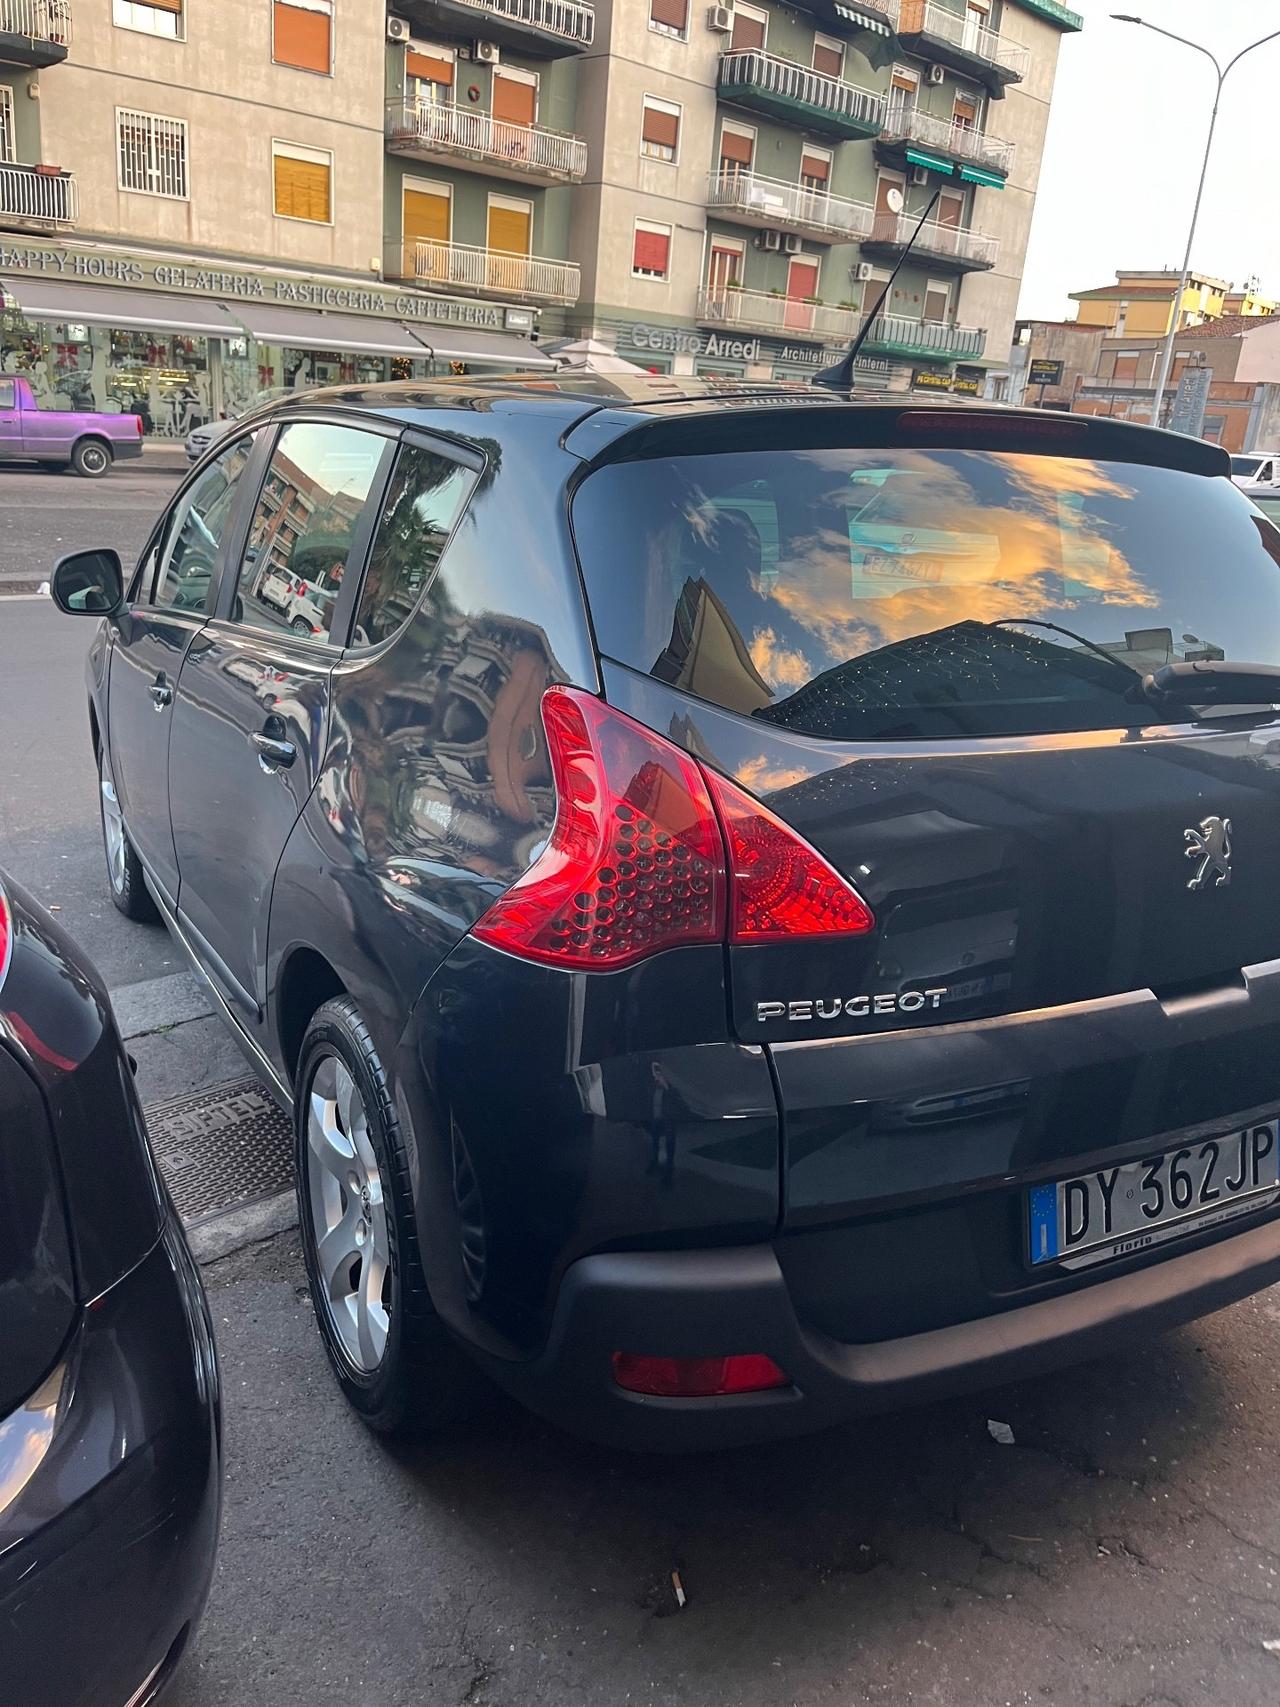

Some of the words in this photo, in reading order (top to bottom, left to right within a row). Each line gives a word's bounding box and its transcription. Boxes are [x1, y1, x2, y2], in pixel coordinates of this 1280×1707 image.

[74, 255, 144, 282] HOURS
[154, 265, 265, 296] GELATERIA
[275, 281, 387, 312] PASTICCERIA
[396, 295, 499, 326] CAFFETTERIA
[631, 323, 701, 354] Centro
[705, 333, 761, 360] Arredi
[853, 354, 889, 371] 'interni
[757, 988, 948, 1022] PEUGEOT
[1065, 1167, 1120, 1246] DY
